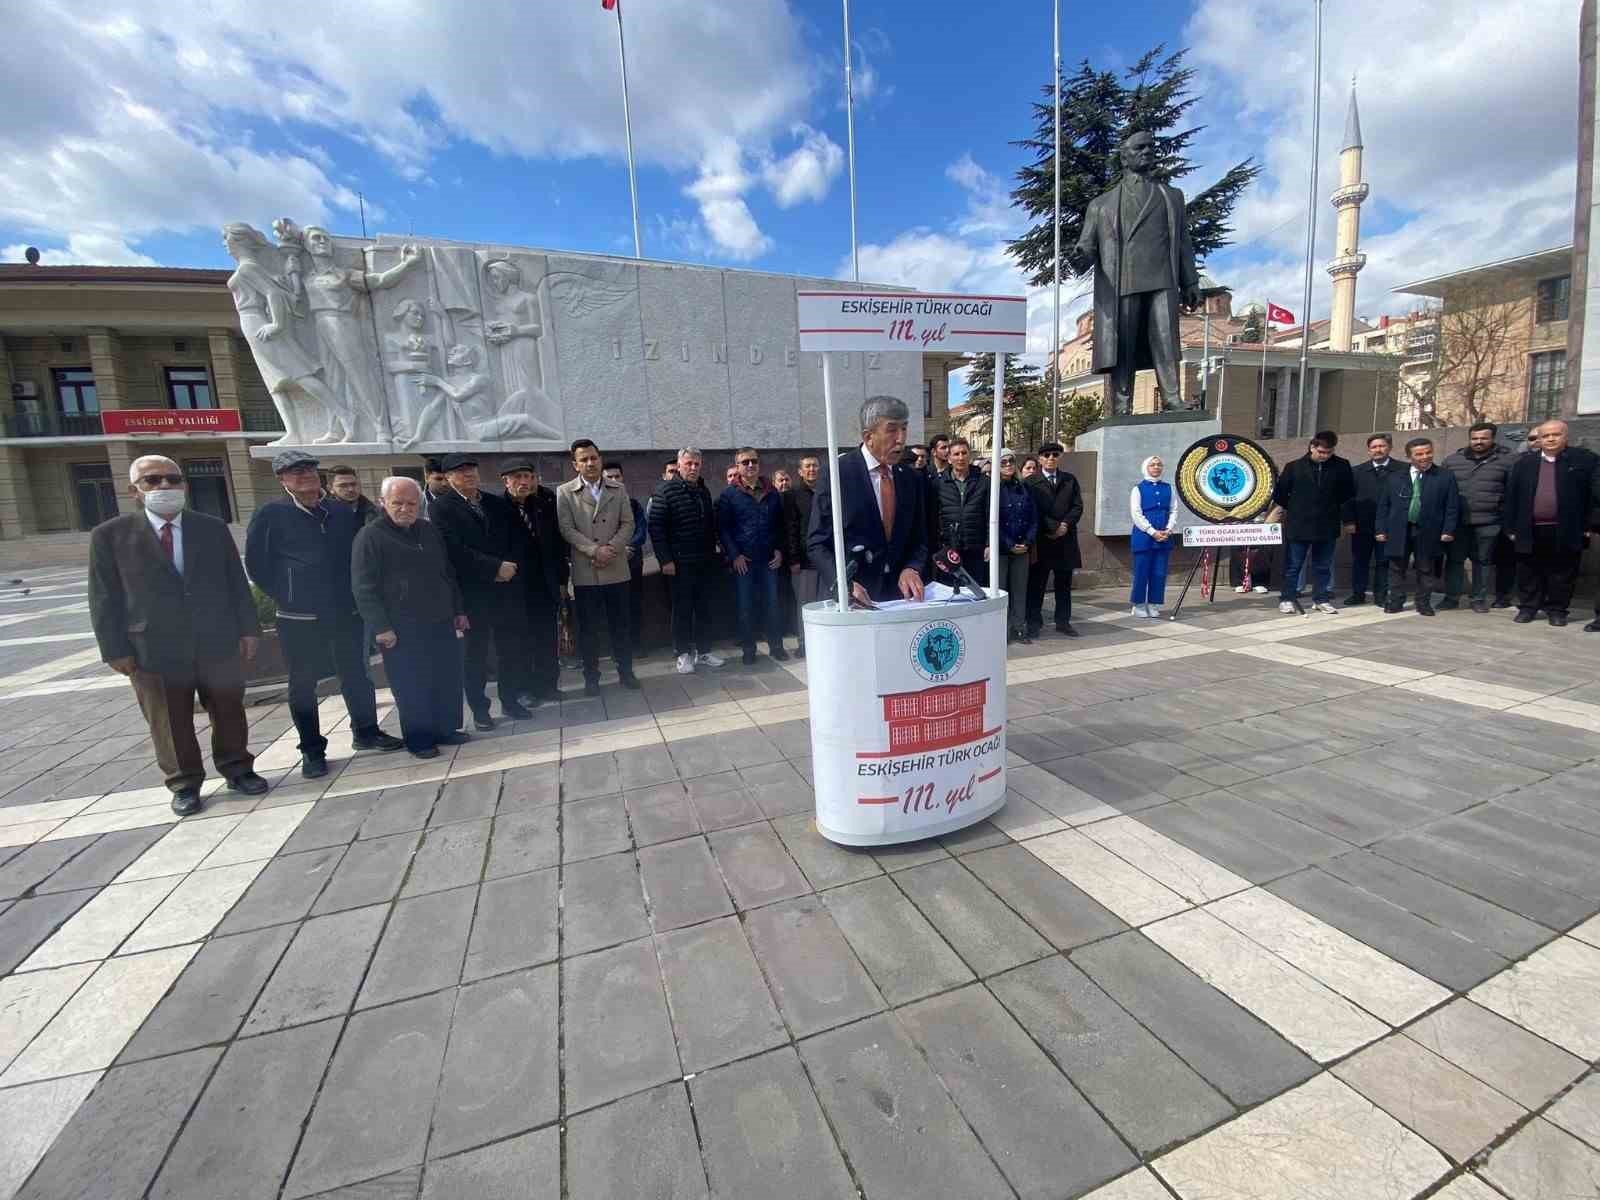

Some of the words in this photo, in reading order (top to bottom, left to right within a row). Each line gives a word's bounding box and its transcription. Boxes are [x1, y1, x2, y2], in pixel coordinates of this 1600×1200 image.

[841, 299, 912, 316] ESKİŞEHİR
[915, 299, 952, 316] TÜRK
[953, 301, 992, 316] OCAĞI
[920, 322, 947, 347] yıl
[857, 755, 935, 777] ESKİŞEHİR
[937, 748, 971, 768] TÜRK
[945, 773, 976, 815] yıl
